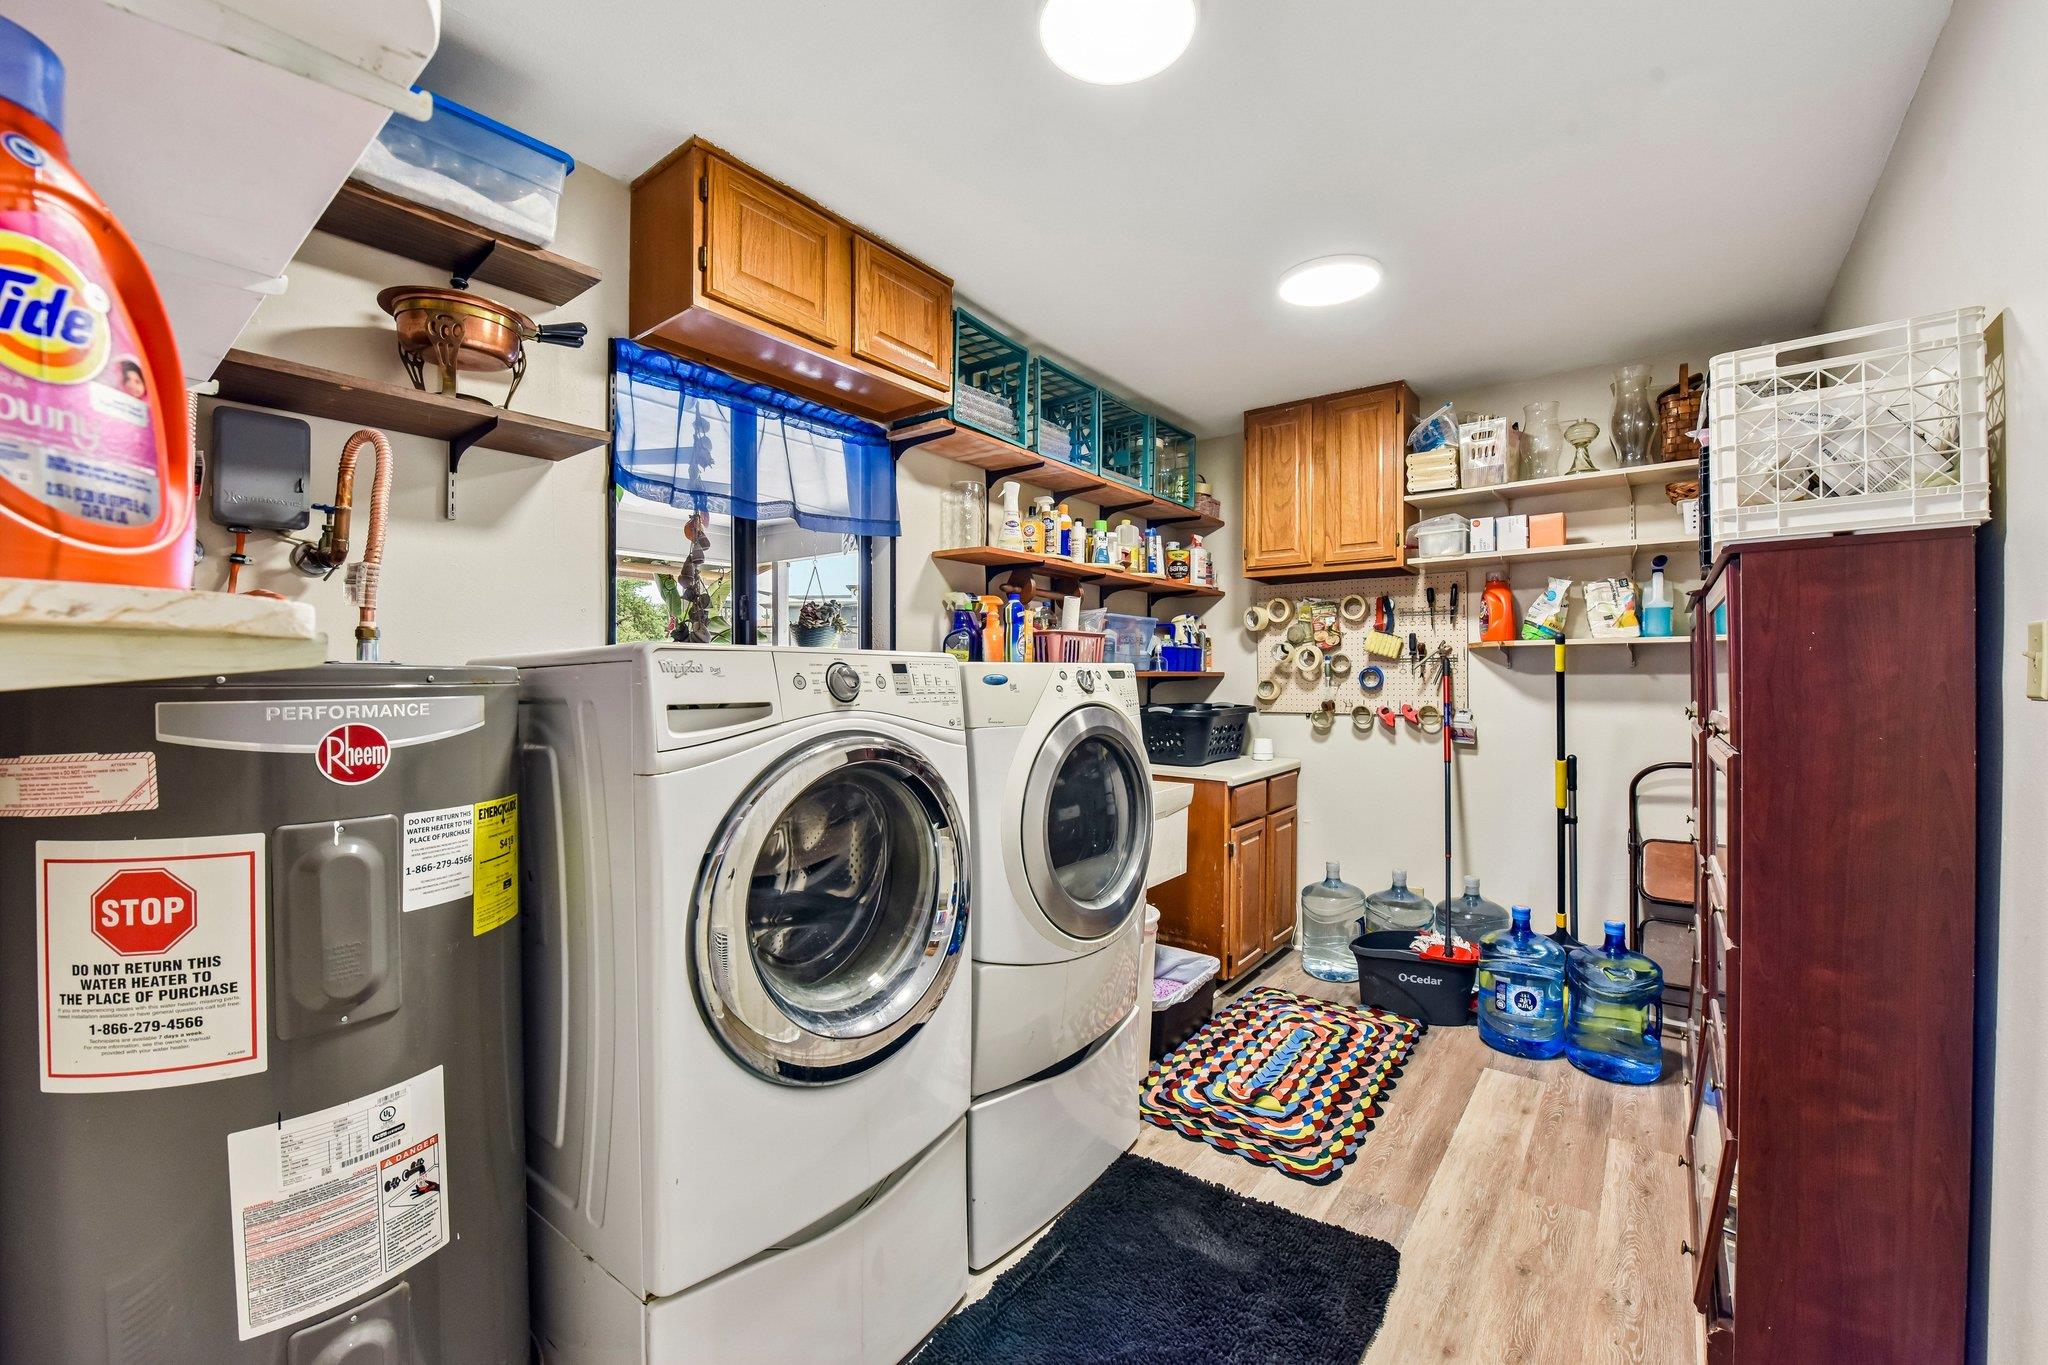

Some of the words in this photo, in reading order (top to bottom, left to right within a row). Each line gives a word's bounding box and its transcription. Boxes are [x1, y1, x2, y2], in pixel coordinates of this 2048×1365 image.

[658, 659, 703, 679] Whirlpool
[266, 702, 430, 721] PERFORMANCE
[326, 725, 386, 775] Rheem
[406, 826, 430, 835] WATER
[430, 822, 454, 831] HEATER
[408, 818, 420, 826] DO
[420, 816, 435, 824] NOT
[435, 813, 459, 822] RETURN
[409, 835, 431, 844] PLACE
[431, 833, 441, 841] OF
[441, 828, 471, 839] PURCHASE
[405, 854, 473, 876] 1-866-279-4566
[101, 896, 185, 927] STOP
[72, 964, 89, 976] DO
[93, 963, 120, 976] NOT
[125, 959, 182, 975] RETURN
[187, 955, 221, 970] THIS
[80, 978, 127, 991] WATER
[131, 973, 187, 989] HEATER
[192, 970, 212, 983] TO
[1398, 973, 1443, 986] O-Cedar
[59, 993, 83, 1005] THE
[87, 992, 130, 1005] PLACE
[135, 990, 154, 1003] OF
[159, 981, 238, 1001] PURCHASE
[175, 1006, 204, 1014] questions
[89, 1015, 204, 1036] 1-866-279-4566
[396, 1137, 436, 1161] DANGER
[352, 1164, 377, 1177] CAUTION
[243, 1199, 274, 1211] WARNING
